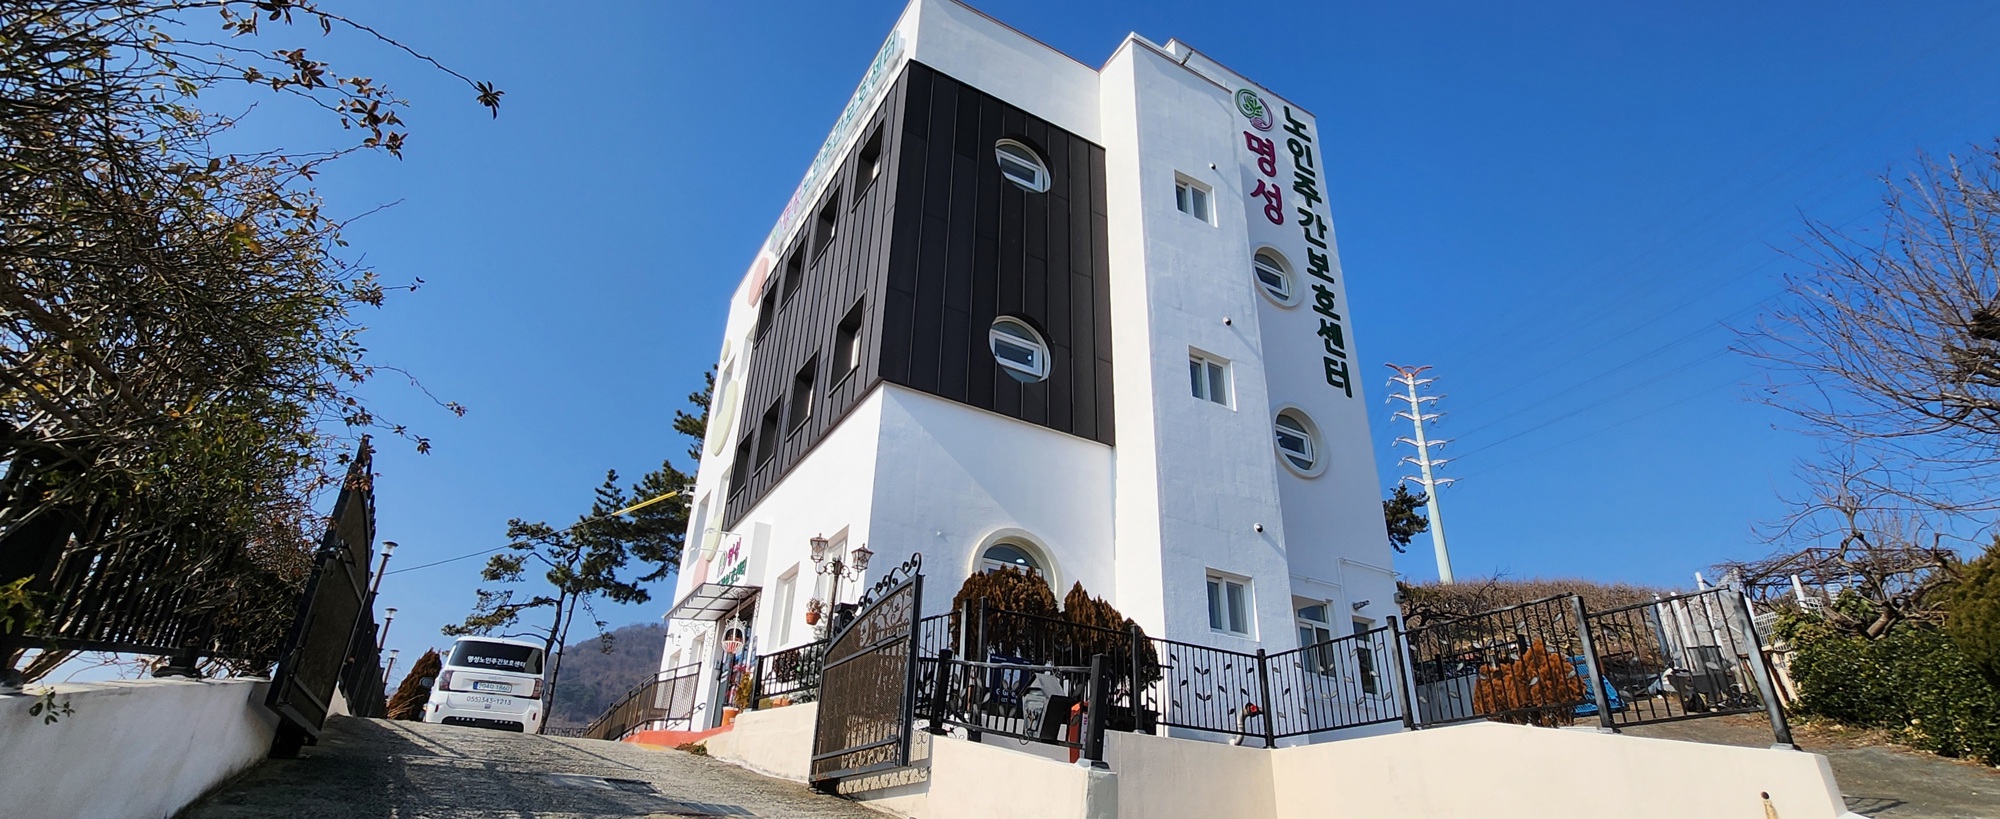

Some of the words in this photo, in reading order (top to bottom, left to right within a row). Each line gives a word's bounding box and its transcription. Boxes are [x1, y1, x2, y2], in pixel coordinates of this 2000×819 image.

[1243, 130, 1285, 226] 명성
[1283, 105, 1353, 399] 노인주간보호센터
[467, 655, 526, 668] 명성노인주간보호센터
[467, 696, 511, 705] 055)343-1213
